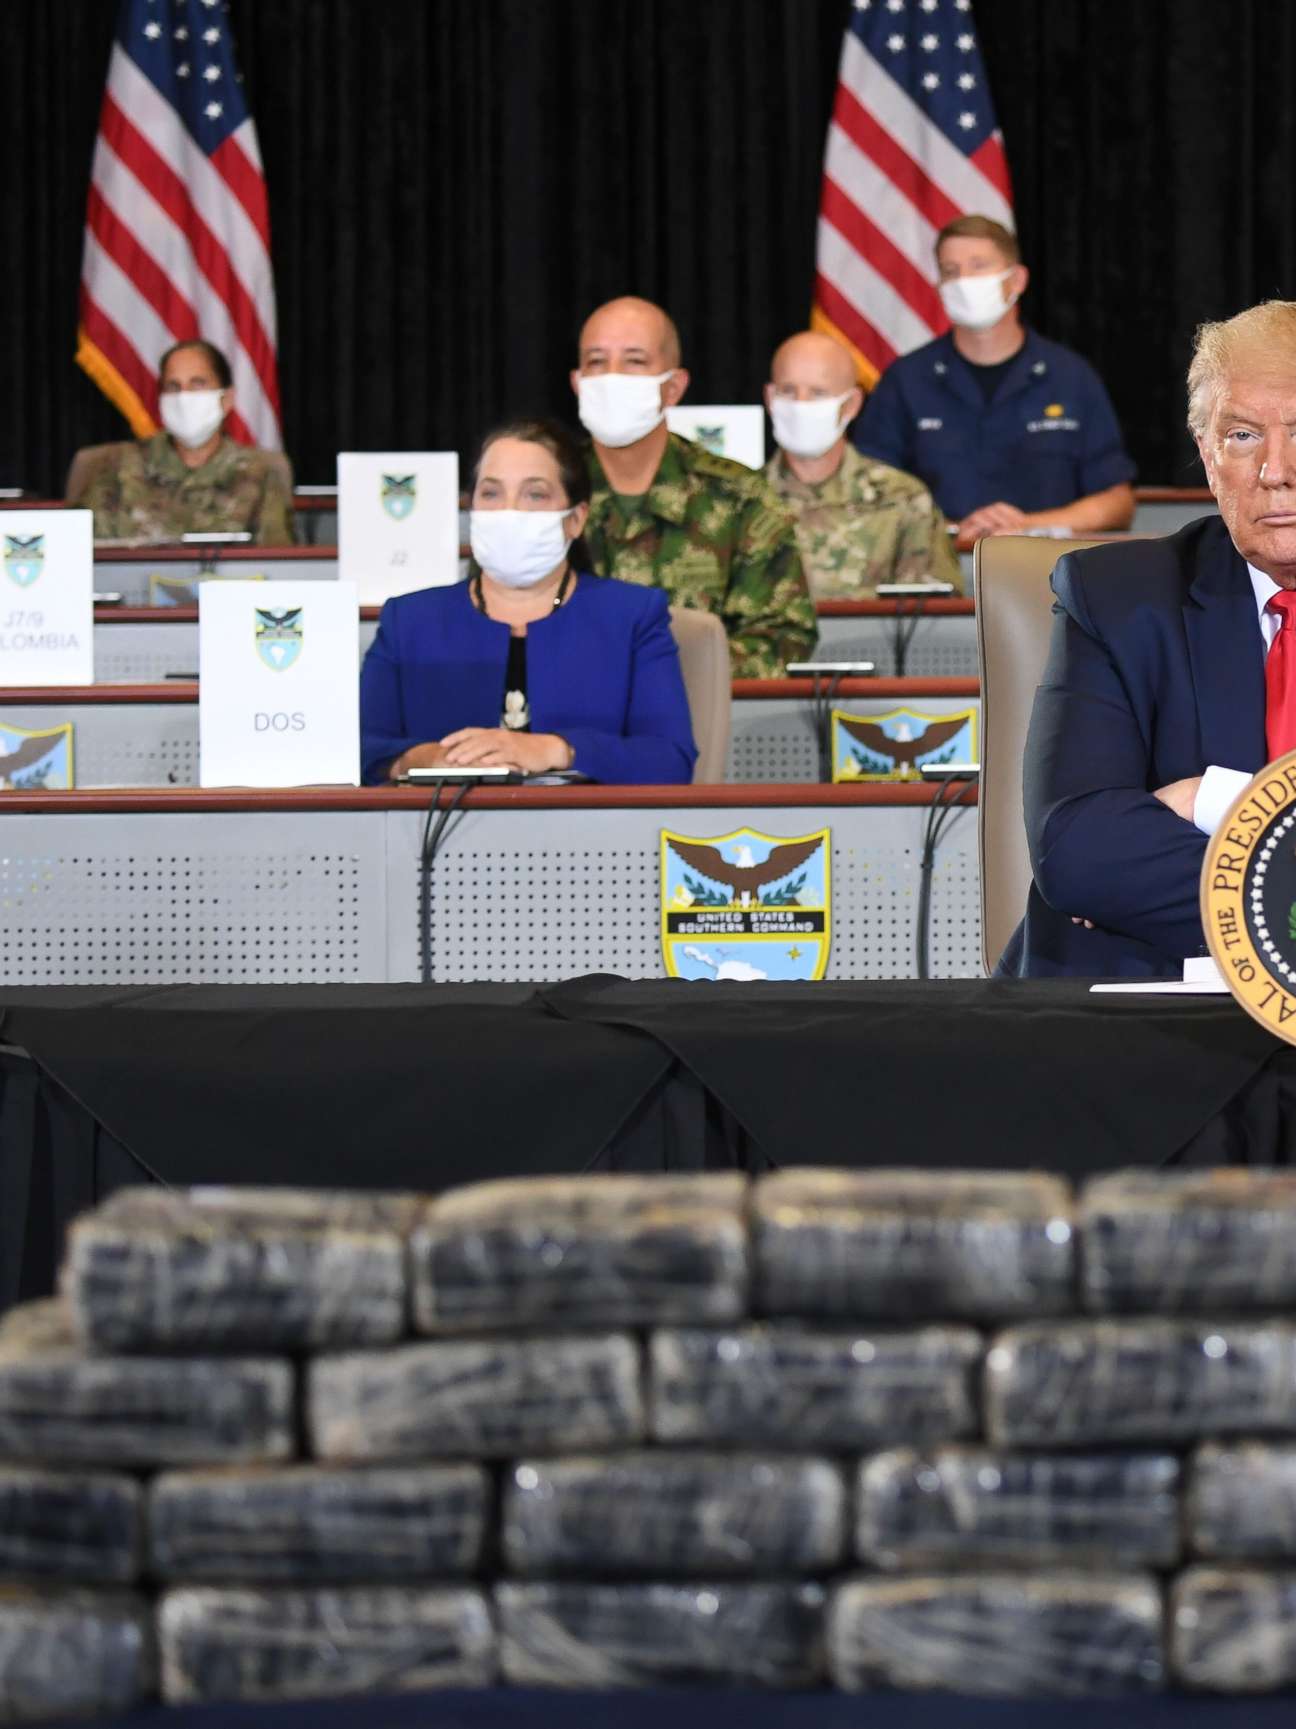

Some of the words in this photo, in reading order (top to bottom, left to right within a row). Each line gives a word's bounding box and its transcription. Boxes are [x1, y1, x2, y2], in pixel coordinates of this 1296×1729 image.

[0, 632, 79, 650] LOMBIA
[254, 711, 306, 731] DOS
[678, 922, 745, 933] SOUTHERN
[752, 921, 814, 933] COMMAND
[696, 912, 743, 923] UNITED
[750, 912, 795, 922] STATES
[1217, 906, 1242, 950] THE
[1232, 956, 1256, 982] OF
